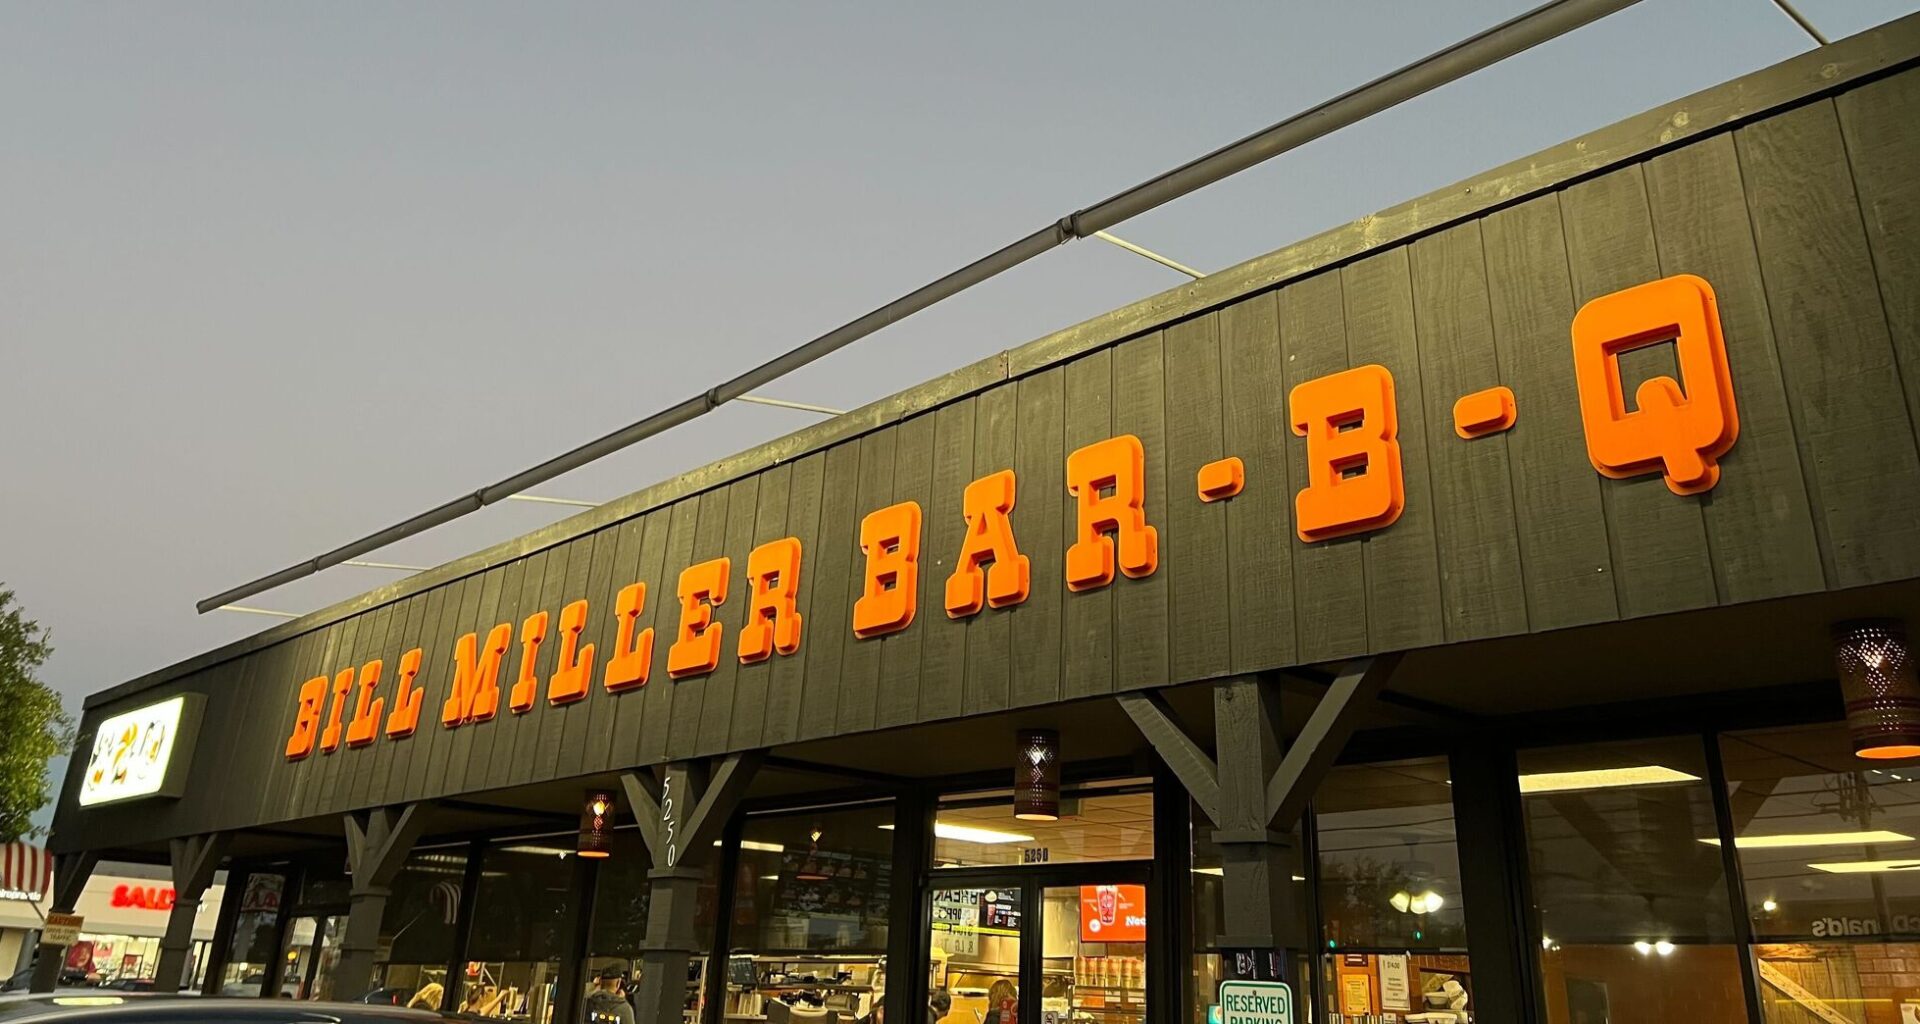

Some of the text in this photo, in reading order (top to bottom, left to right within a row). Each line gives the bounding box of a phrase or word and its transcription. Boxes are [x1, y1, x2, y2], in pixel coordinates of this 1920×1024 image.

[286, 648, 425, 759] BILL
[442, 537, 804, 726] MILLER
[662, 776, 676, 867] 5250
[1024, 847, 1049, 863] 5250
[1226, 994, 1286, 1015] RESERVED
